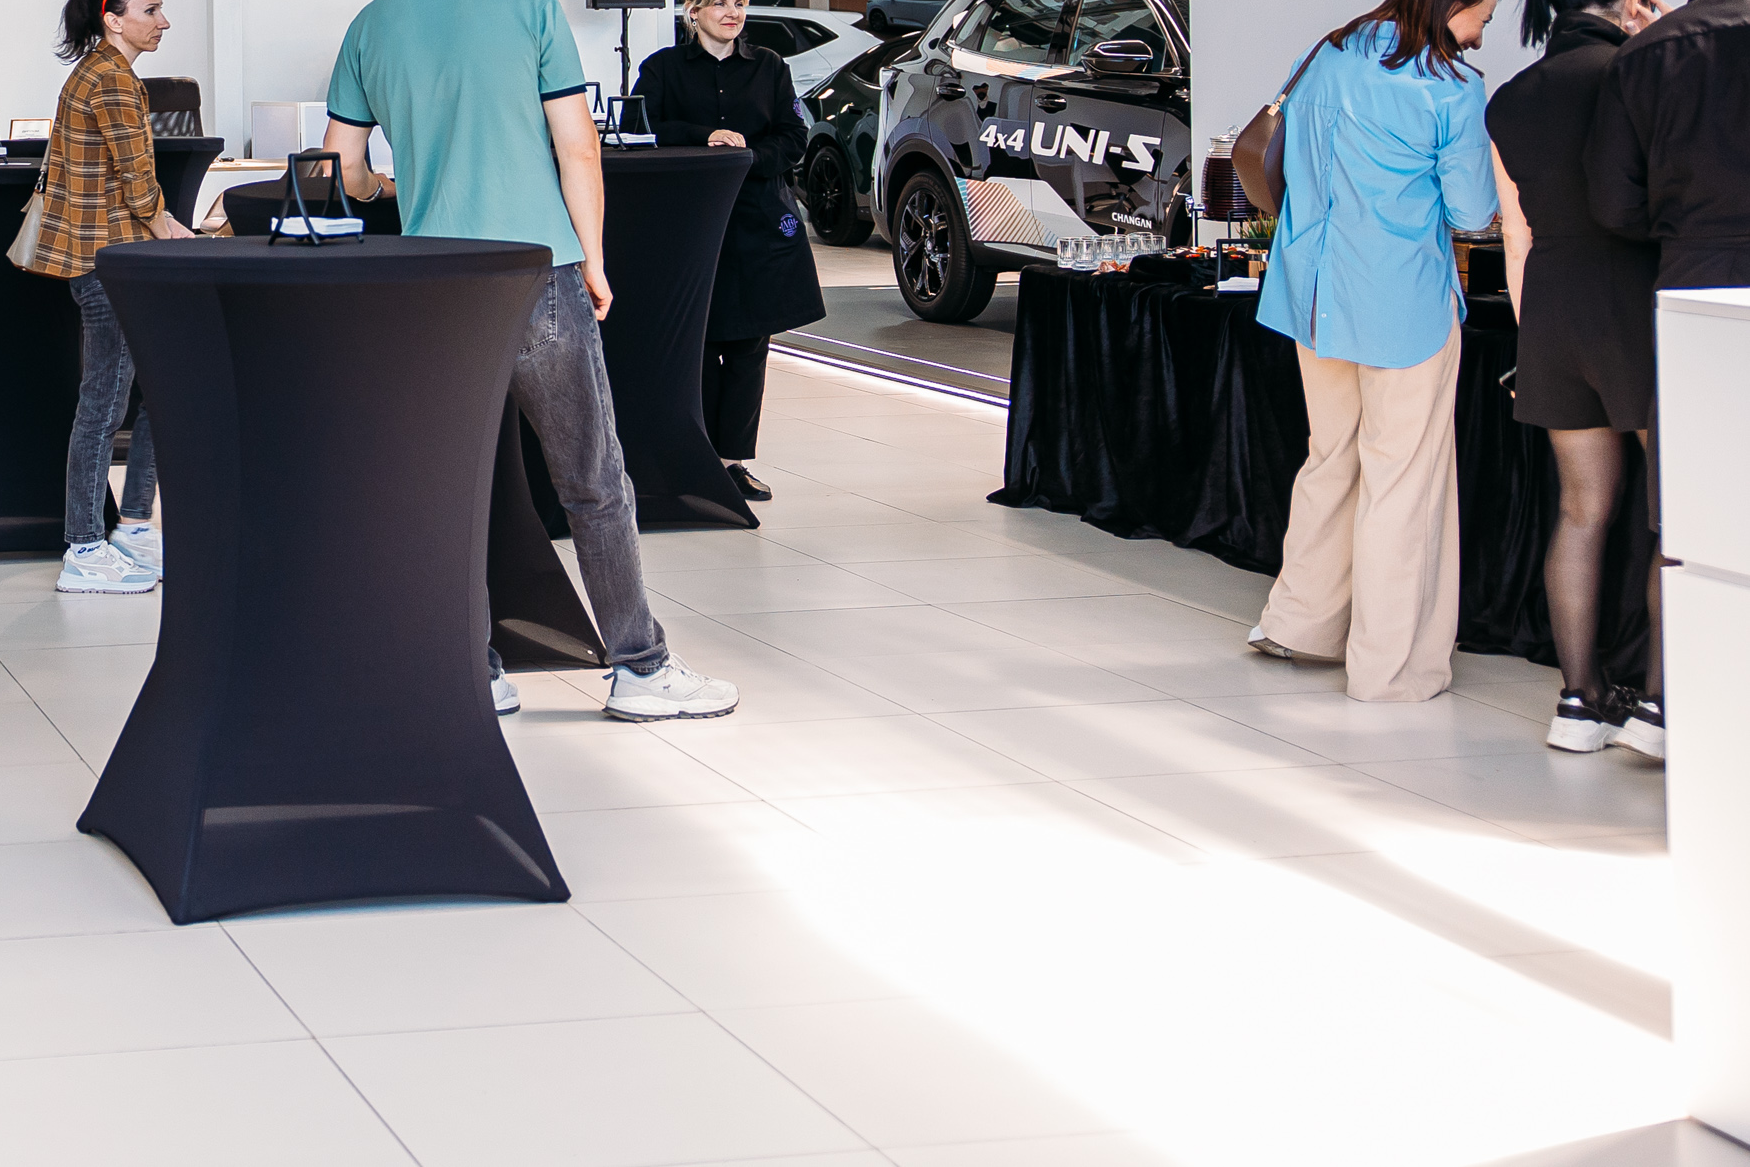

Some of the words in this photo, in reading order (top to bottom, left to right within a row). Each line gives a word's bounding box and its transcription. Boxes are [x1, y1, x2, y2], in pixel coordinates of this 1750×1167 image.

[979, 125, 1025, 151] 4x4
[1031, 121, 1162, 173] UNI-S
[1111, 211, 1152, 230] CHANGAN
